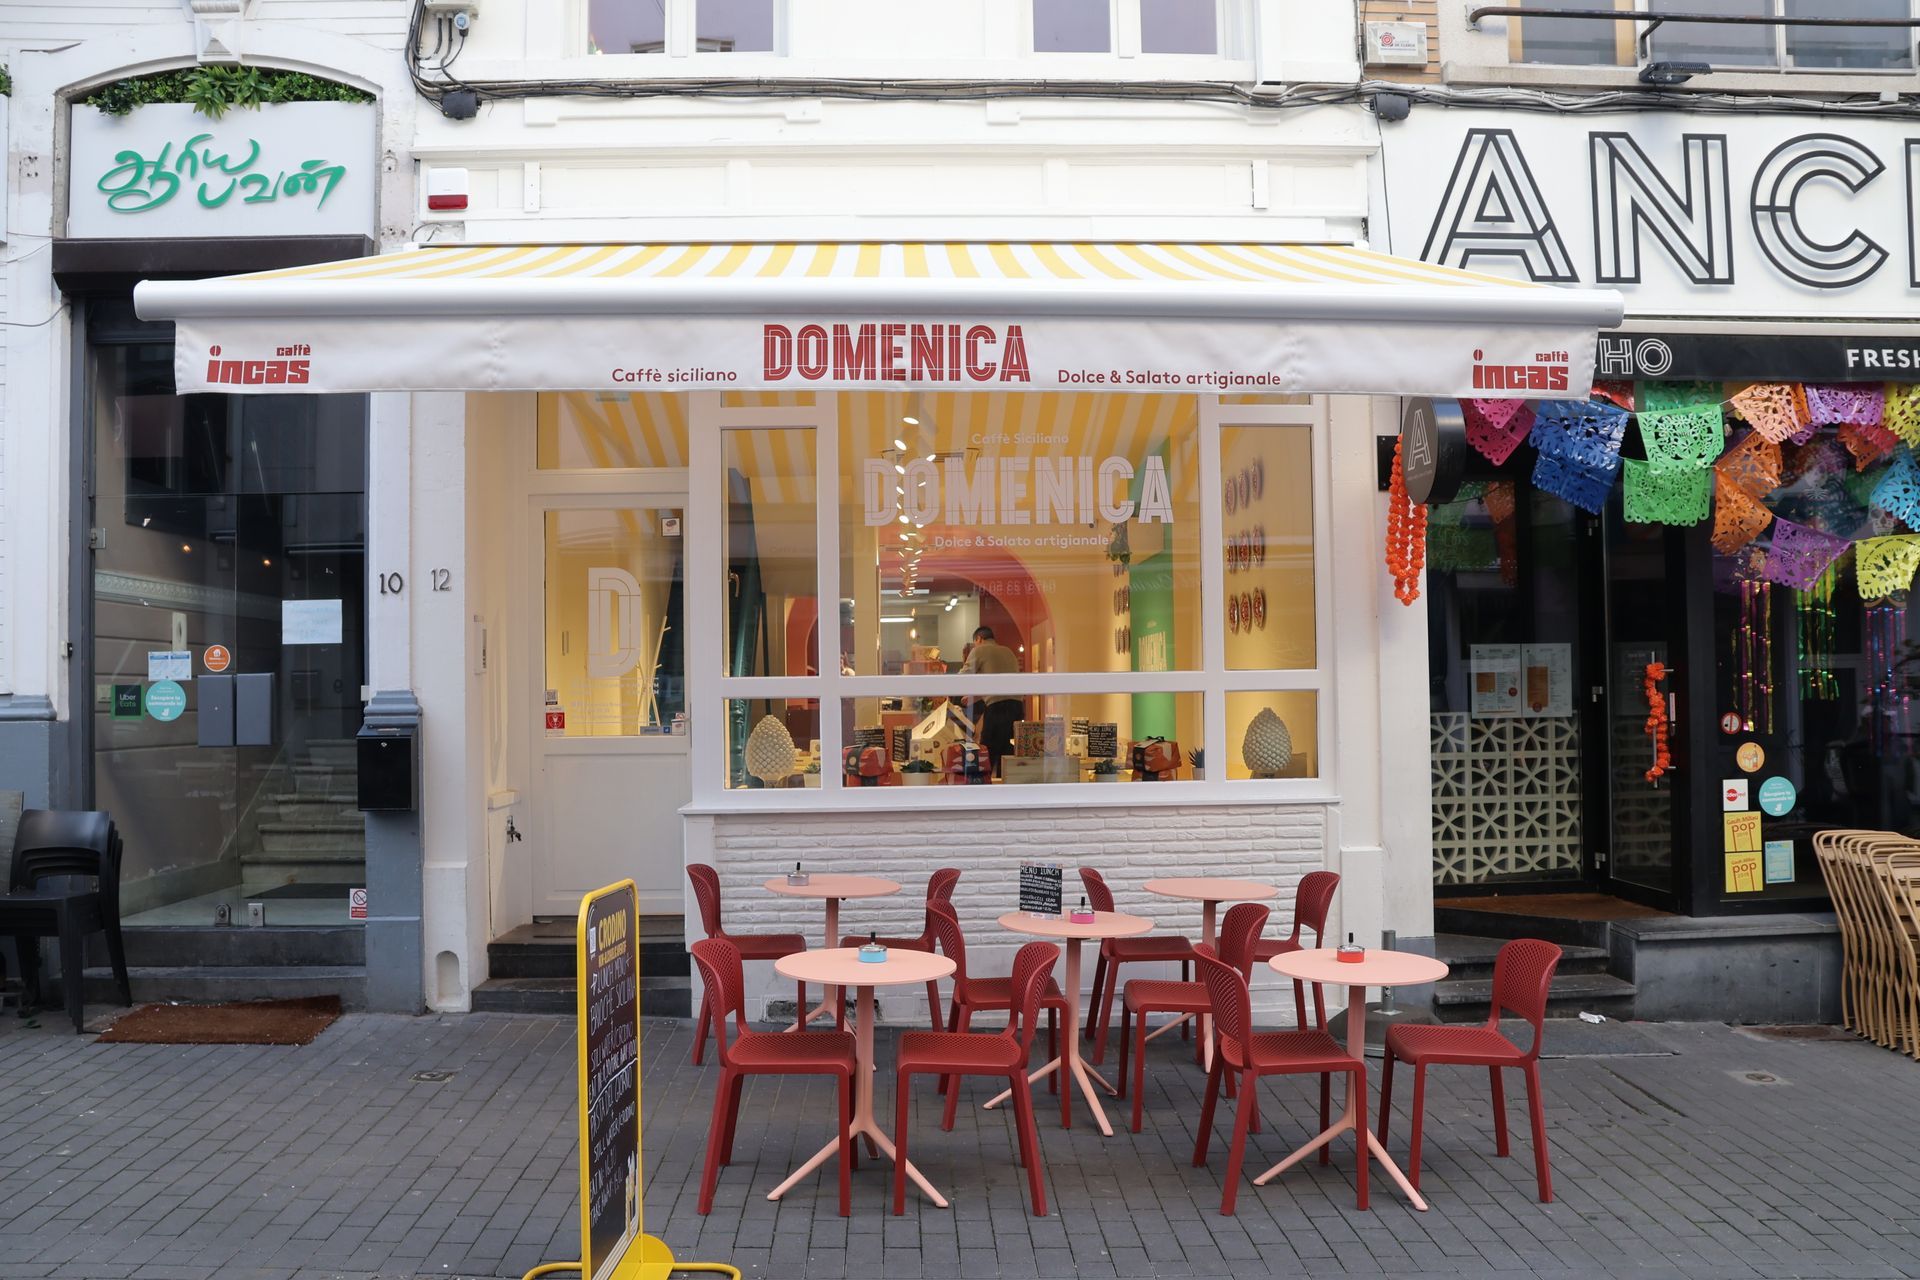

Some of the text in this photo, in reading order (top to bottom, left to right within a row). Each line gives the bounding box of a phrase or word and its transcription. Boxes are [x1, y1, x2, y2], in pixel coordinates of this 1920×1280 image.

[276, 344, 311, 356] caffè
[763, 324, 1031, 382] DOMENICA
[1535, 351, 1569, 362] caffè
[1594, 338, 1673, 376] HO
[206, 345, 310, 385] incas
[612, 367, 737, 383] Caffè siciliano
[1472, 349, 1569, 390] incas
[1058, 369, 1281, 389] Dolce & Salato artigianale
[972, 433, 1069, 445] Caffè Siciliano
[1408, 408, 1432, 472] A
[864, 456, 1174, 526] DOMENICA
[935, 534, 1110, 549] Dolce & Salato artigianale
[379, 572, 403, 595] 10
[431, 568, 451, 592] 12
[588, 567, 641, 679] D
[119, 693, 136, 701] Uber
[1020, 865, 1060, 876] MENU LUNCH
[598, 909, 627, 951] CRODINO
